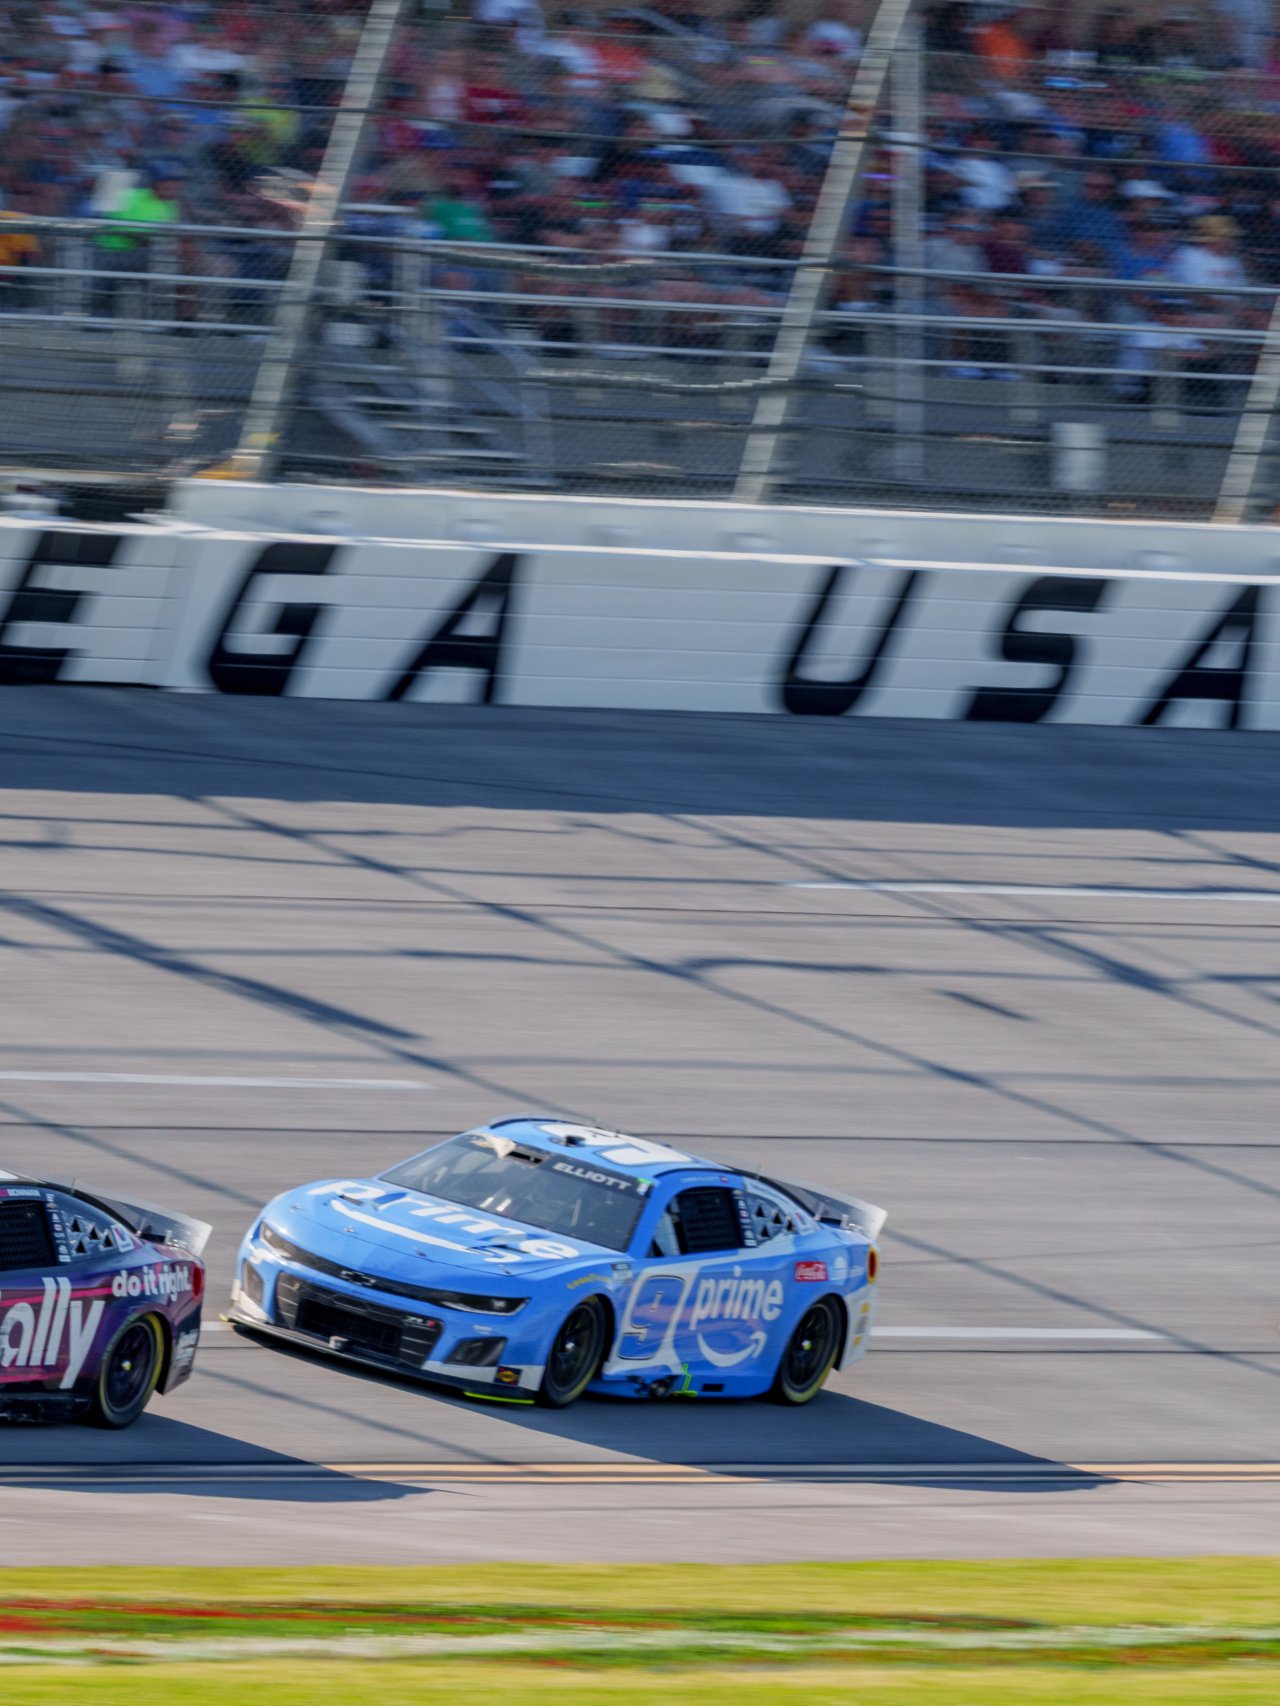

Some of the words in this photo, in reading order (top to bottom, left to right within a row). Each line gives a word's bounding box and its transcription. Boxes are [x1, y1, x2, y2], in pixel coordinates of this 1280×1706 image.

[782, 566, 1264, 732] USA
[553, 1162, 632, 1192] ELLIOTT
[113, 1270, 140, 1297] do
[143, 1266, 160, 1295] it
[612, 1269, 688, 1366] 9
[690, 1265, 783, 1331] prime
